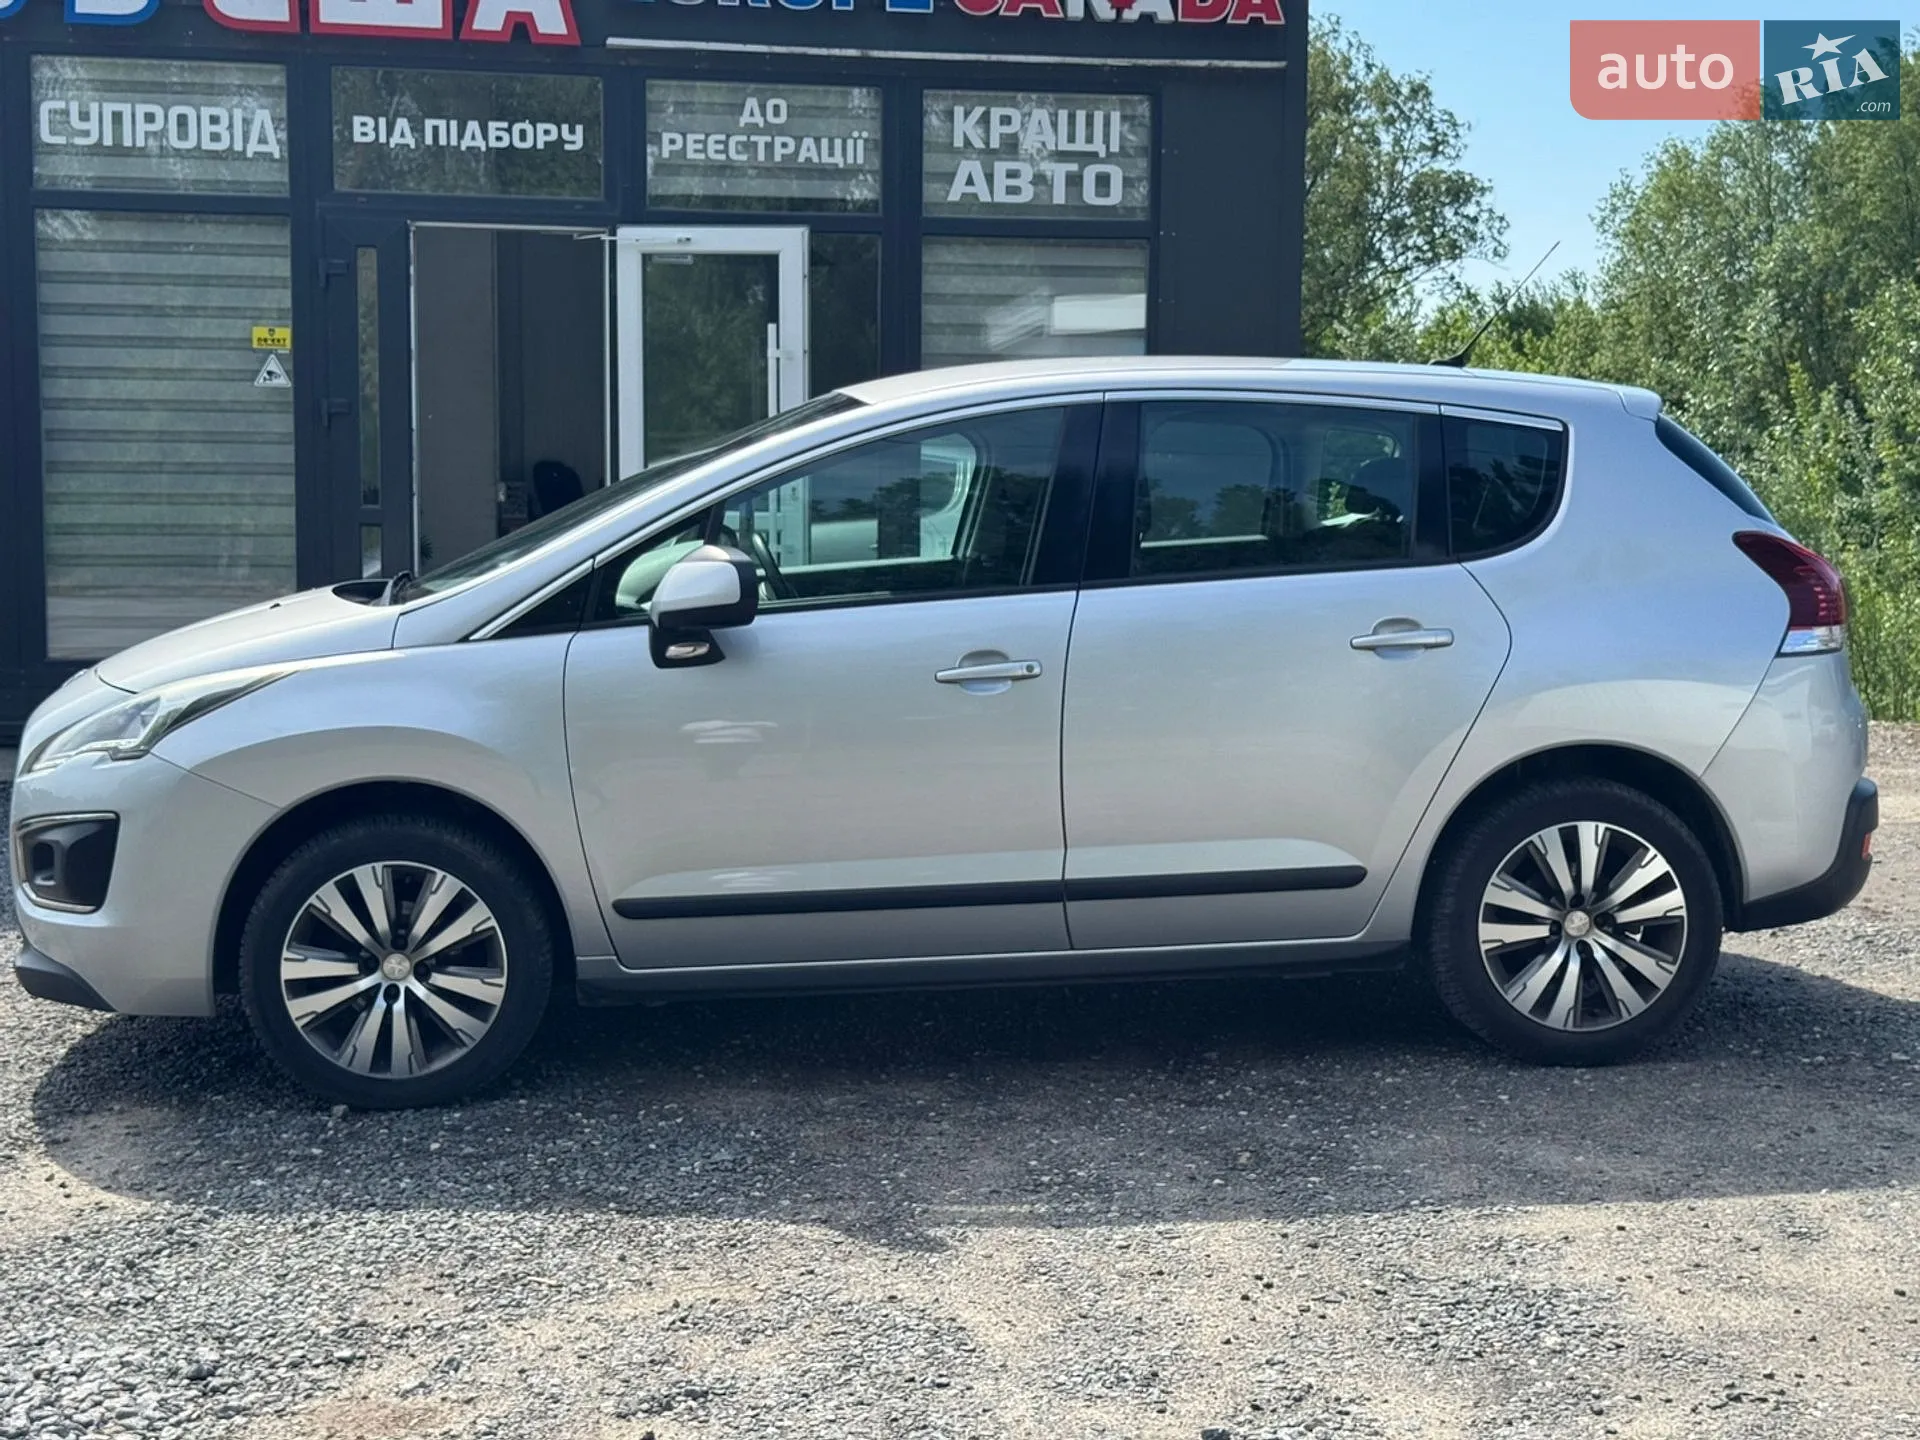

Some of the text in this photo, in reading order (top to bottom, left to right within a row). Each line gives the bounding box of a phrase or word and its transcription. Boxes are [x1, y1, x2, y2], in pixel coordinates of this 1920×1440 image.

[39, 100, 281, 159] СУПРОВІД
[352, 115, 584, 151] ВІД ПІДБОРУ
[739, 97, 788, 128] ДО
[953, 105, 1121, 158] КРАЩІ
[661, 131, 869, 168] РЕЄСТРАЦІЇ
[946, 160, 1123, 206] АВТО
